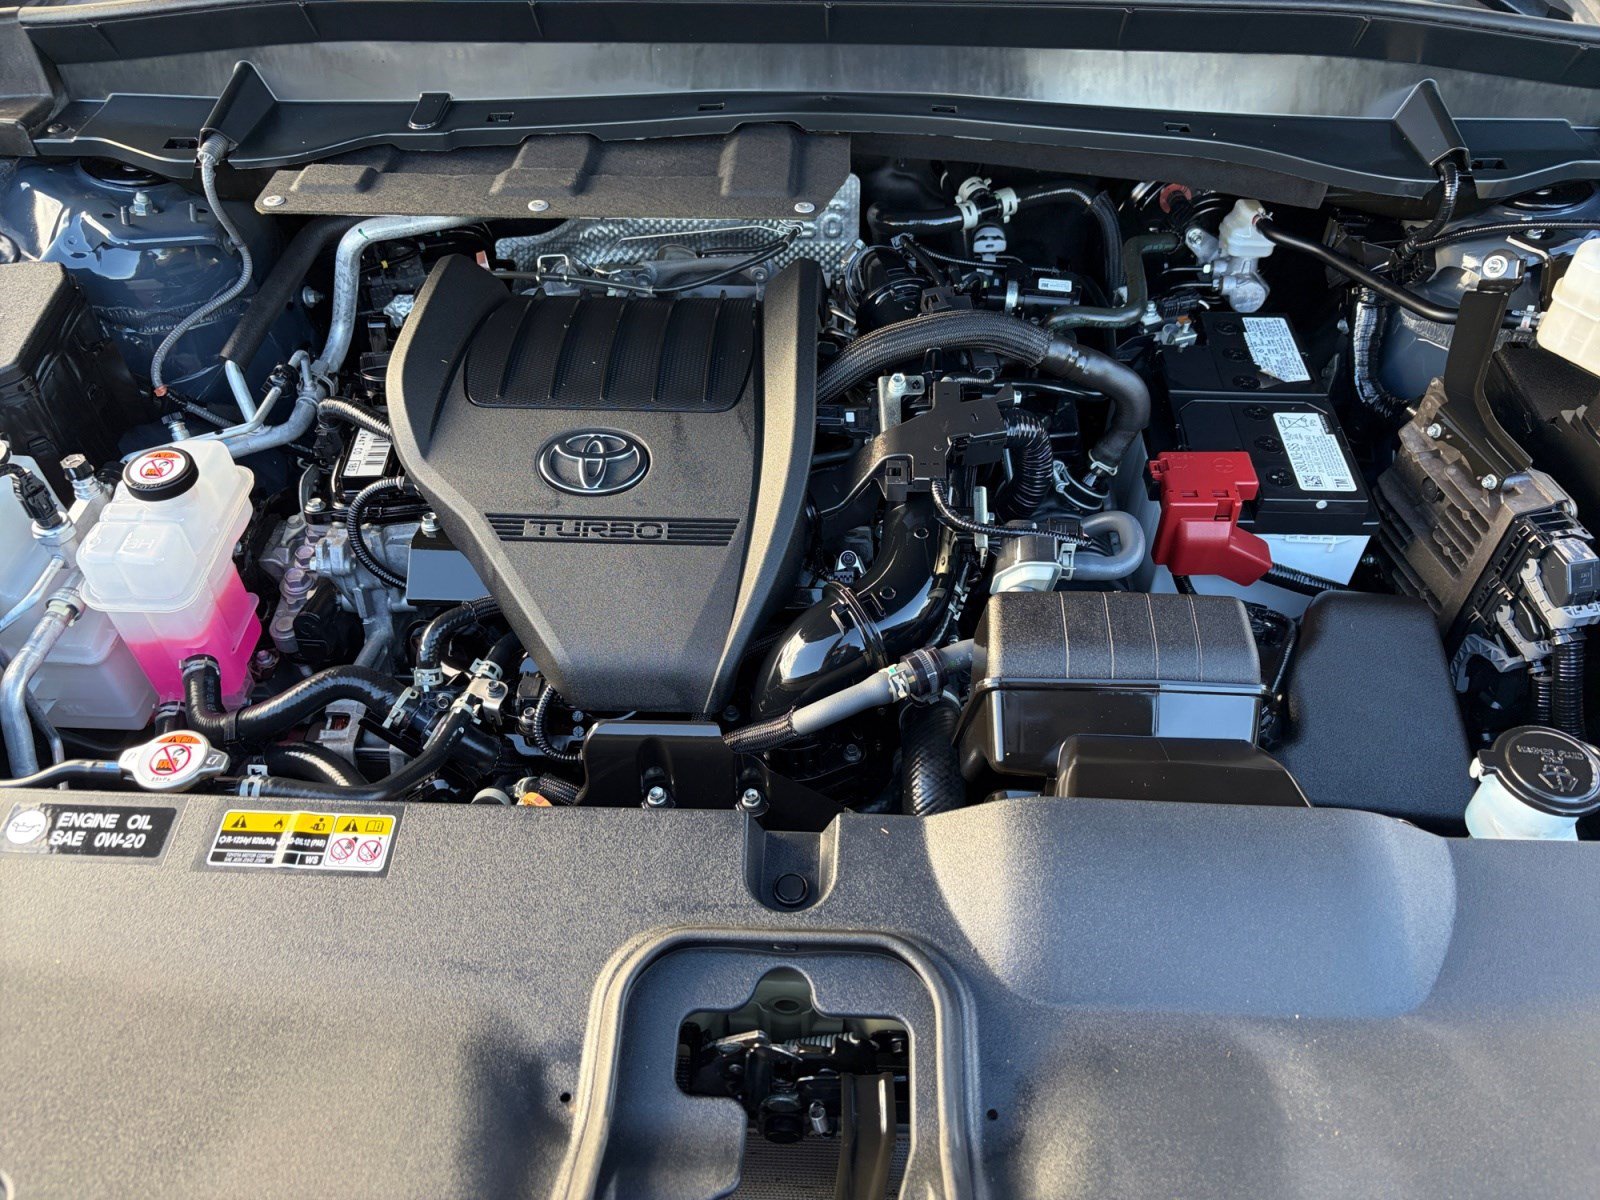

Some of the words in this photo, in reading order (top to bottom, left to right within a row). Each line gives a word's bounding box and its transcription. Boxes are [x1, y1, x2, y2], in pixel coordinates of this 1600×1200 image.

[527, 520, 665, 540] TURBO
[1516, 745, 1555, 756] WASHER
[1558, 750, 1584, 761] FLUID
[57, 811, 120, 829] ENGINE
[127, 814, 153, 830] OIL
[49, 830, 86, 847] SAE
[94, 832, 146, 849] 0W-20
[305, 855, 319, 864] WS
